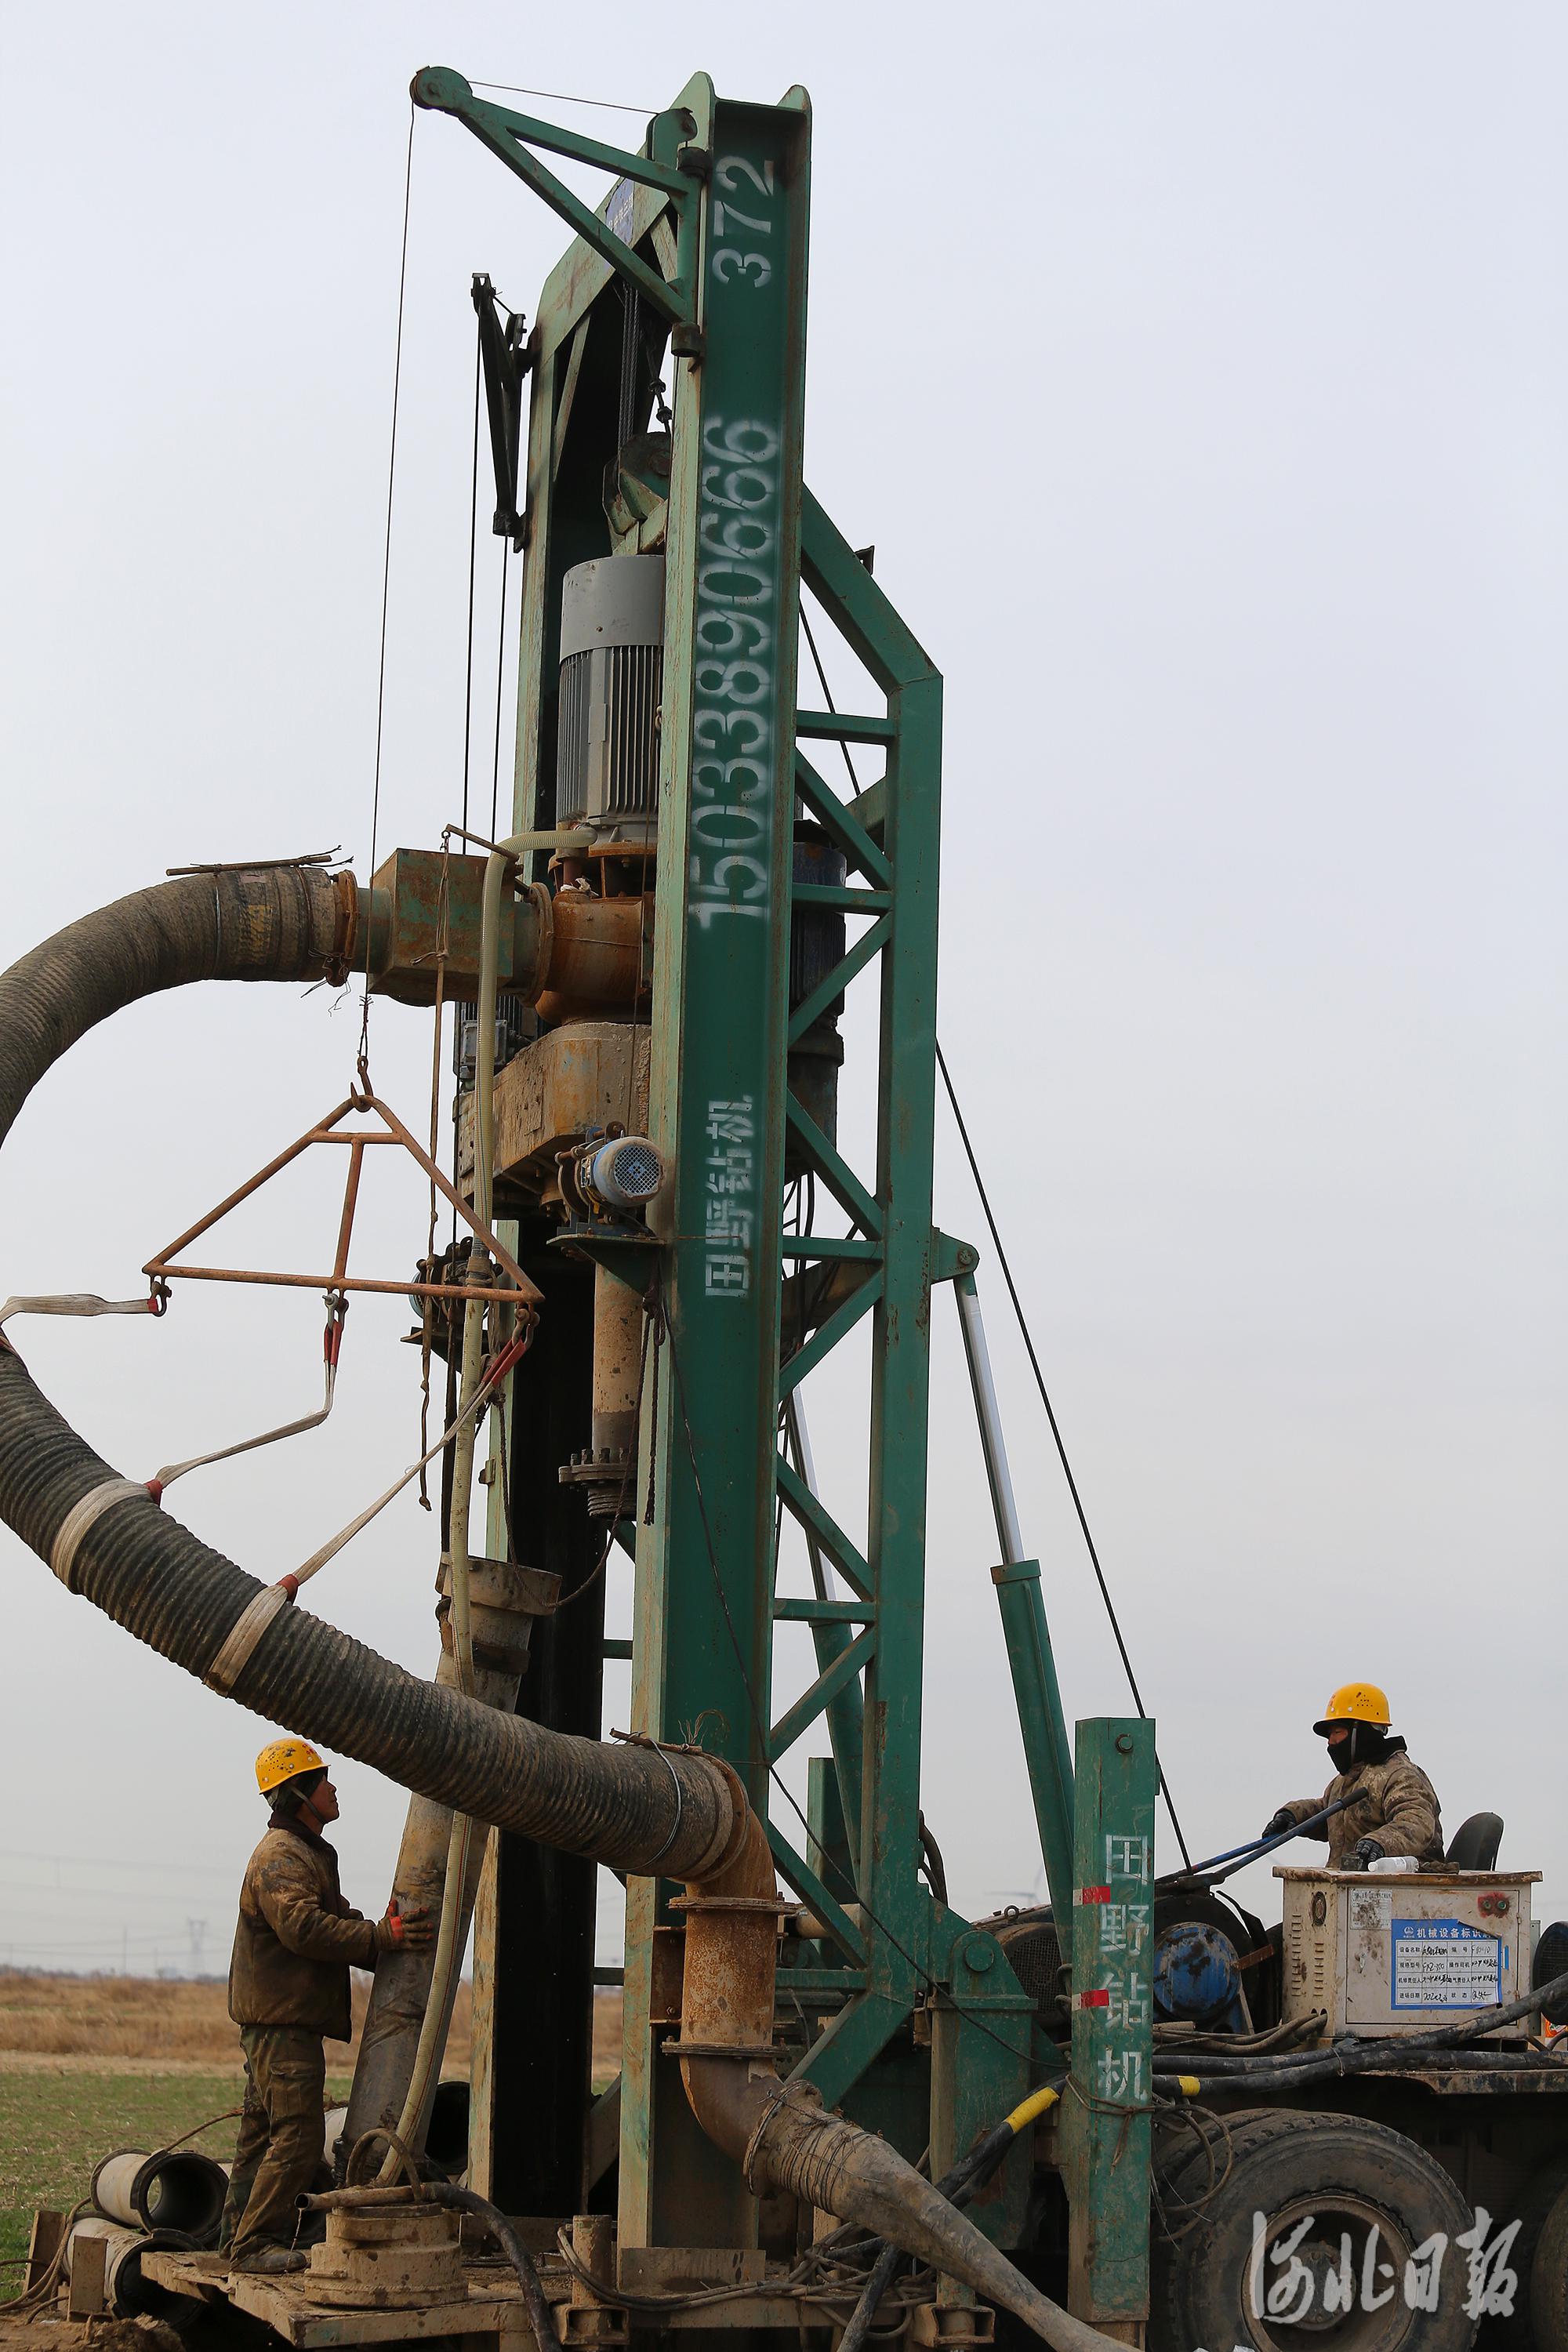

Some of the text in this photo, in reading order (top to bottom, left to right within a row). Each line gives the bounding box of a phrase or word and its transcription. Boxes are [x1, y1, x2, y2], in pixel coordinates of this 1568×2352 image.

[713, 158, 776, 288] 372
[690, 415, 779, 930] 15033890666
[706, 1094, 753, 1298] 田野钻机
[1099, 1834, 1151, 2102] 田野钻机
